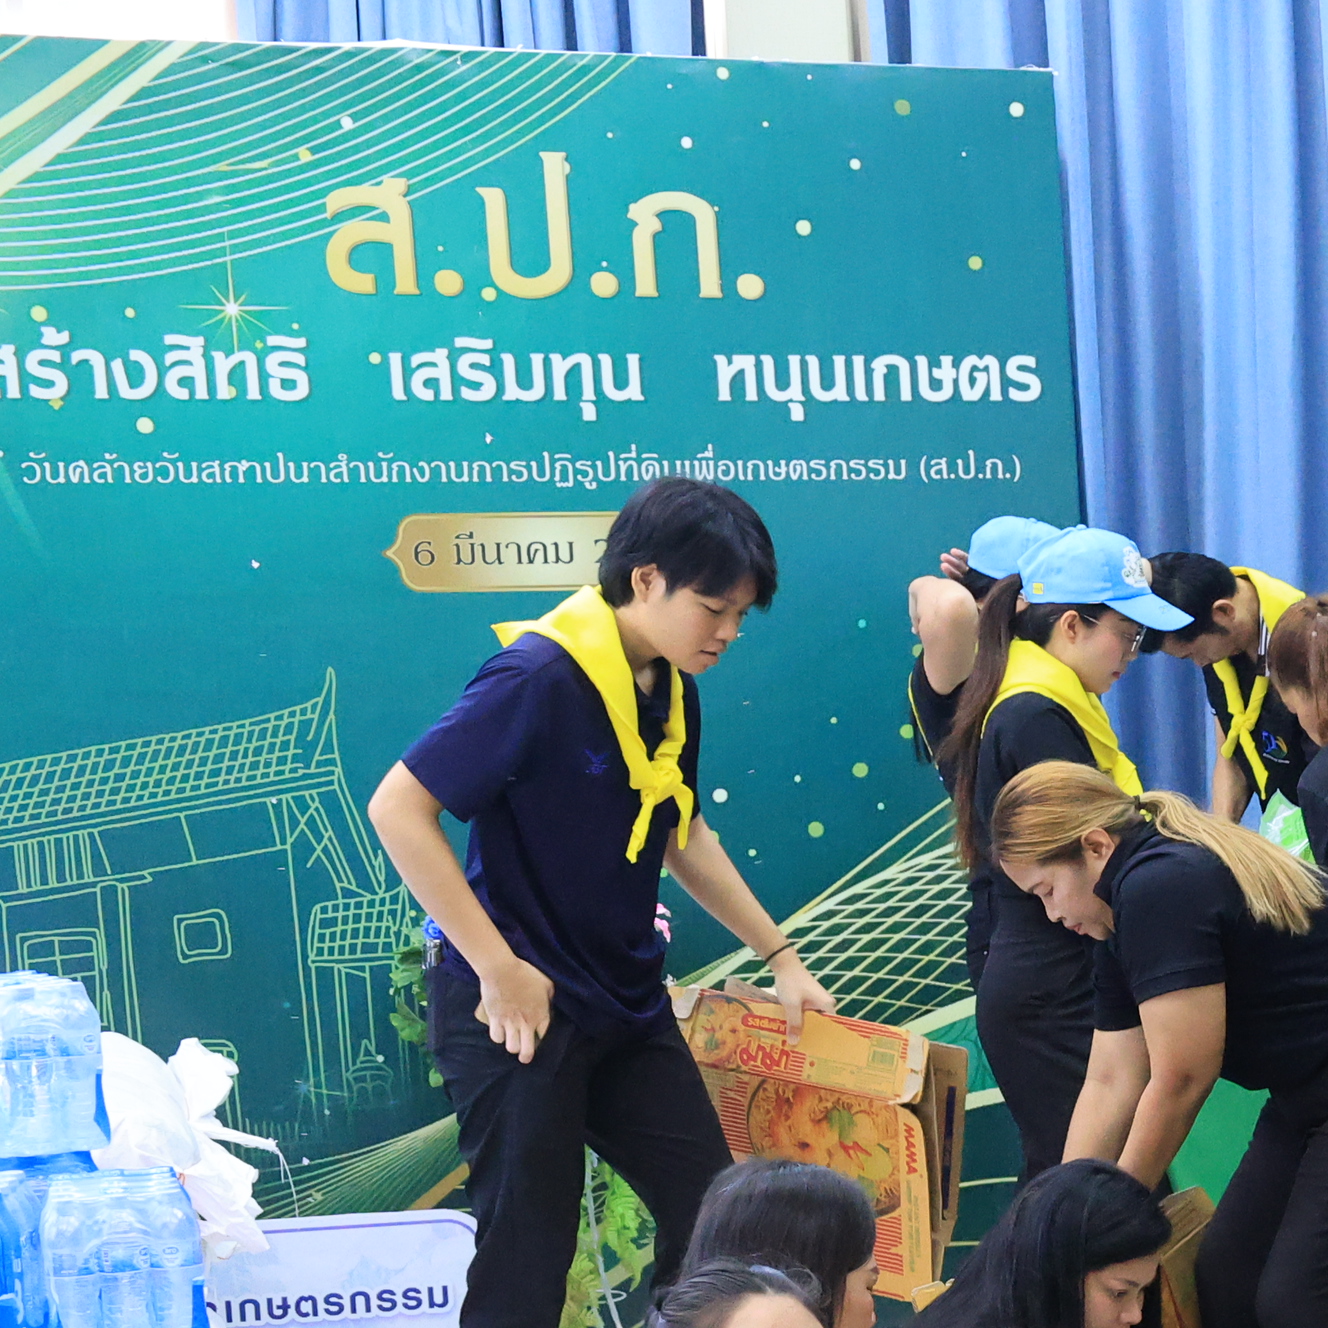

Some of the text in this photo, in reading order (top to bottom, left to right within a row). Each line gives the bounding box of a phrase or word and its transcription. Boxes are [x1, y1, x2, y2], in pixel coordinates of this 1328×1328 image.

[325, 151, 766, 302] ส.ป.ก.
[390, 337, 645, 421] เสริมทุน
[714, 343, 1043, 421] หนุนเกษตร
[919, 450, 1022, 483] (ส.ป.ก.)
[412, 540, 436, 567] 6
[453, 532, 575, 567] มีนาคม
[902, 1122, 919, 1176] MAMA
